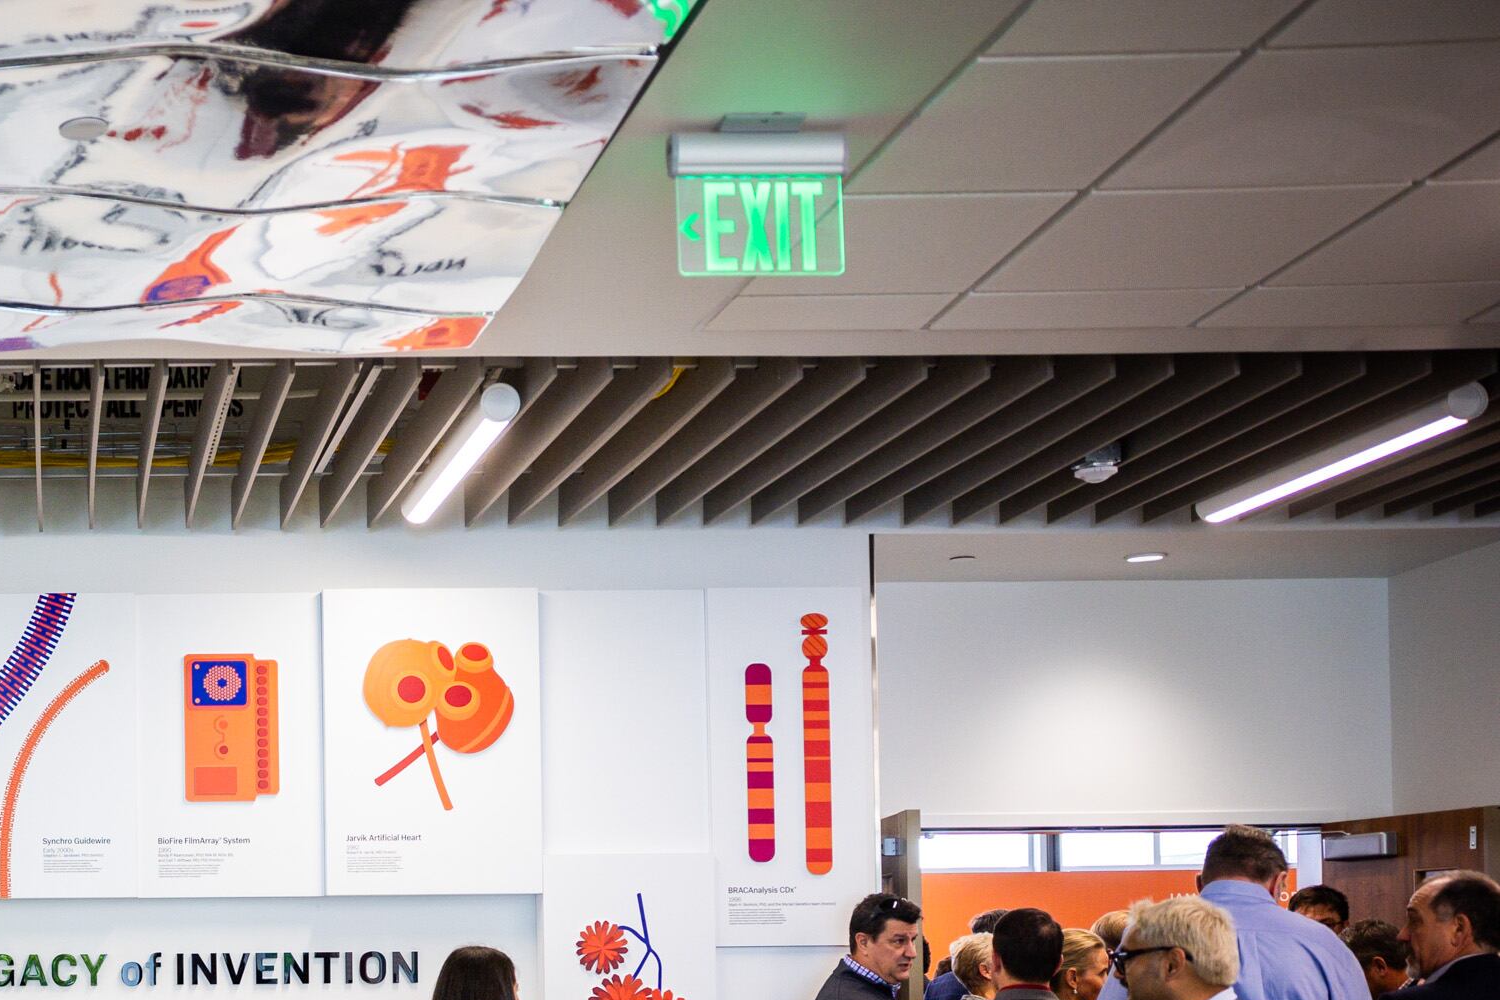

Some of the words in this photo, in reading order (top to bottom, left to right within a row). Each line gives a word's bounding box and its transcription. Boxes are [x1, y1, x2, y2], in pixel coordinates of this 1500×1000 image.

[703, 182, 823, 272] EXIT
[12, 400, 90, 418] PROTEC
[106, 400, 141, 418] ALL
[42, 837, 73, 846] Synchro
[73, 837, 111, 845] Guidewire
[157, 836, 183, 845] BioFire
[223, 836, 251, 845] System
[346, 834, 367, 842] Jarvik
[120, 952, 162, 987] of
[176, 951, 418, 985] INVENTION
